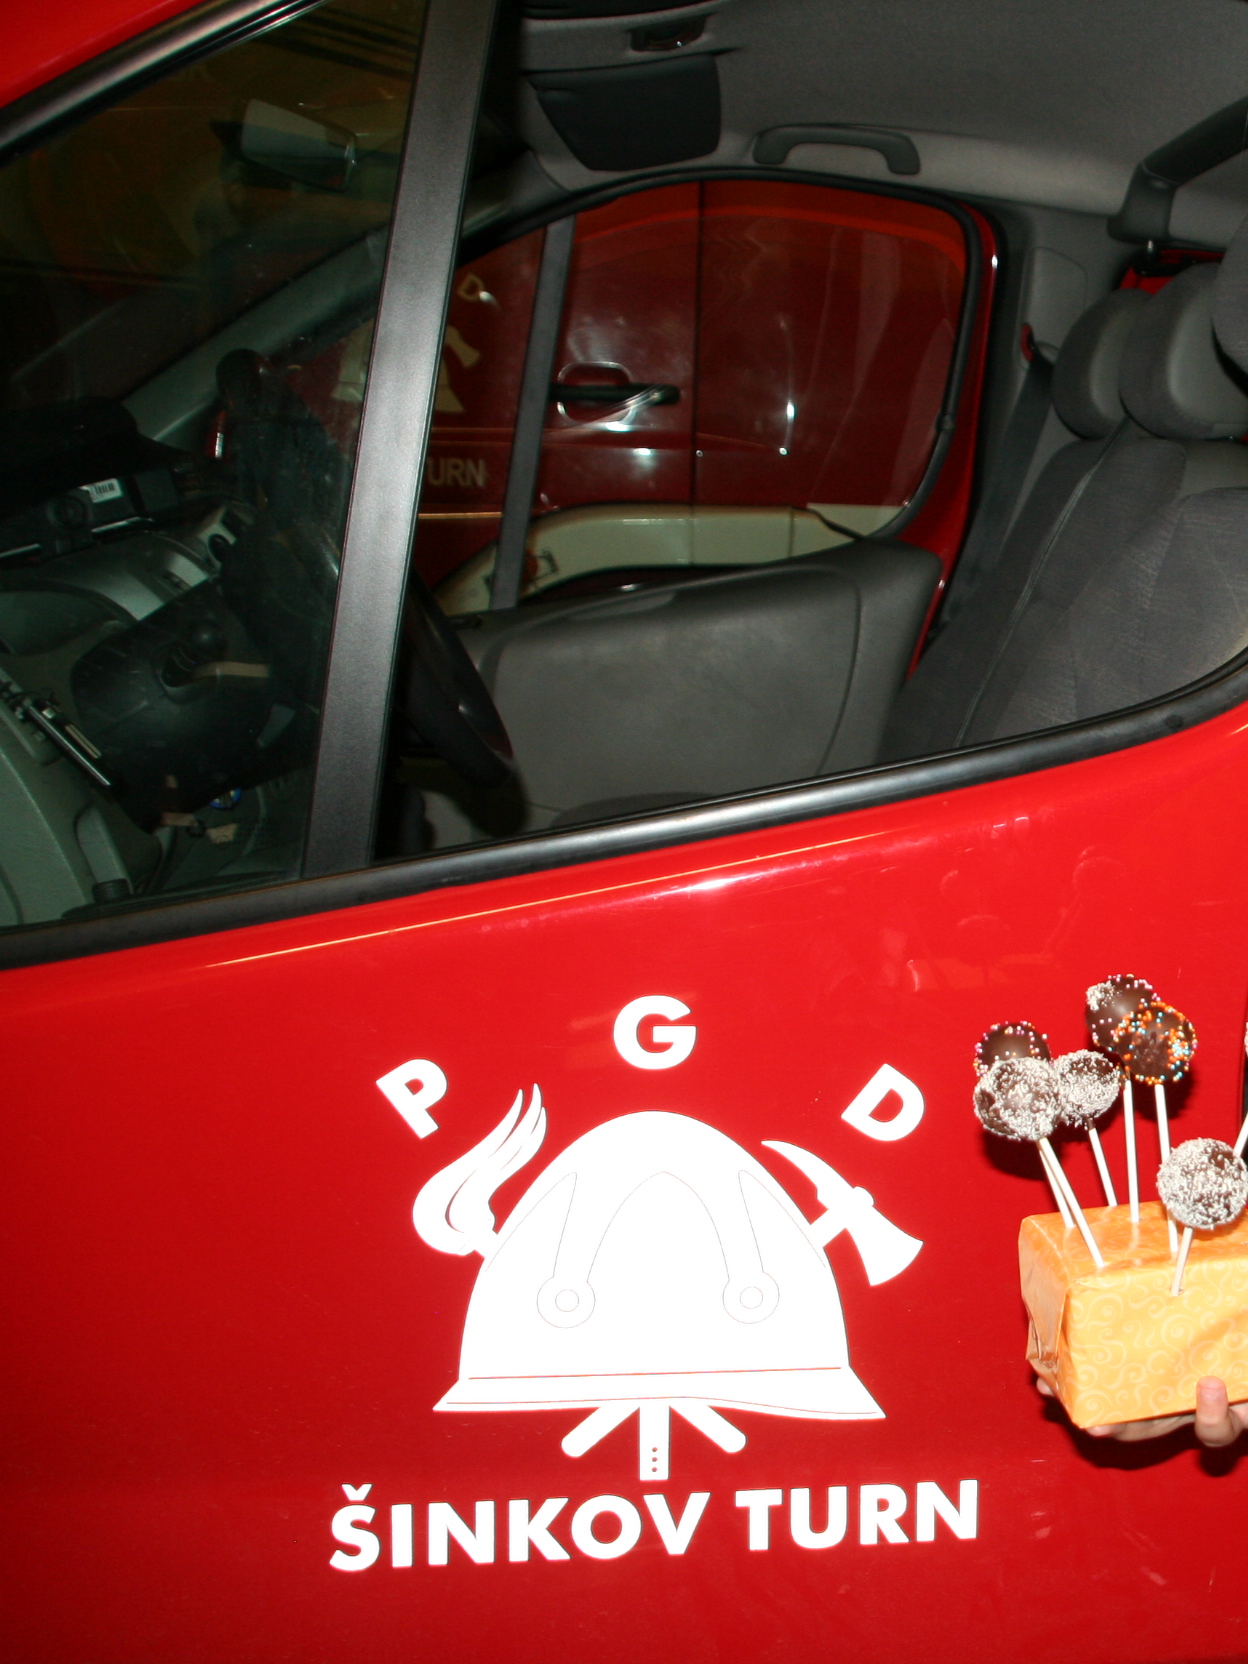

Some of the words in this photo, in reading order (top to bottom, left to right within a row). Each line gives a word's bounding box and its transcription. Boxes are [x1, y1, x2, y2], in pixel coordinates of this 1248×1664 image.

[427, 456, 487, 488] URN
[376, 1058, 448, 1140] P
[613, 994, 697, 1071] G
[841, 1063, 925, 1142] D
[329, 1483, 711, 1572] ŠINKOV
[735, 1479, 979, 1552] TURN
